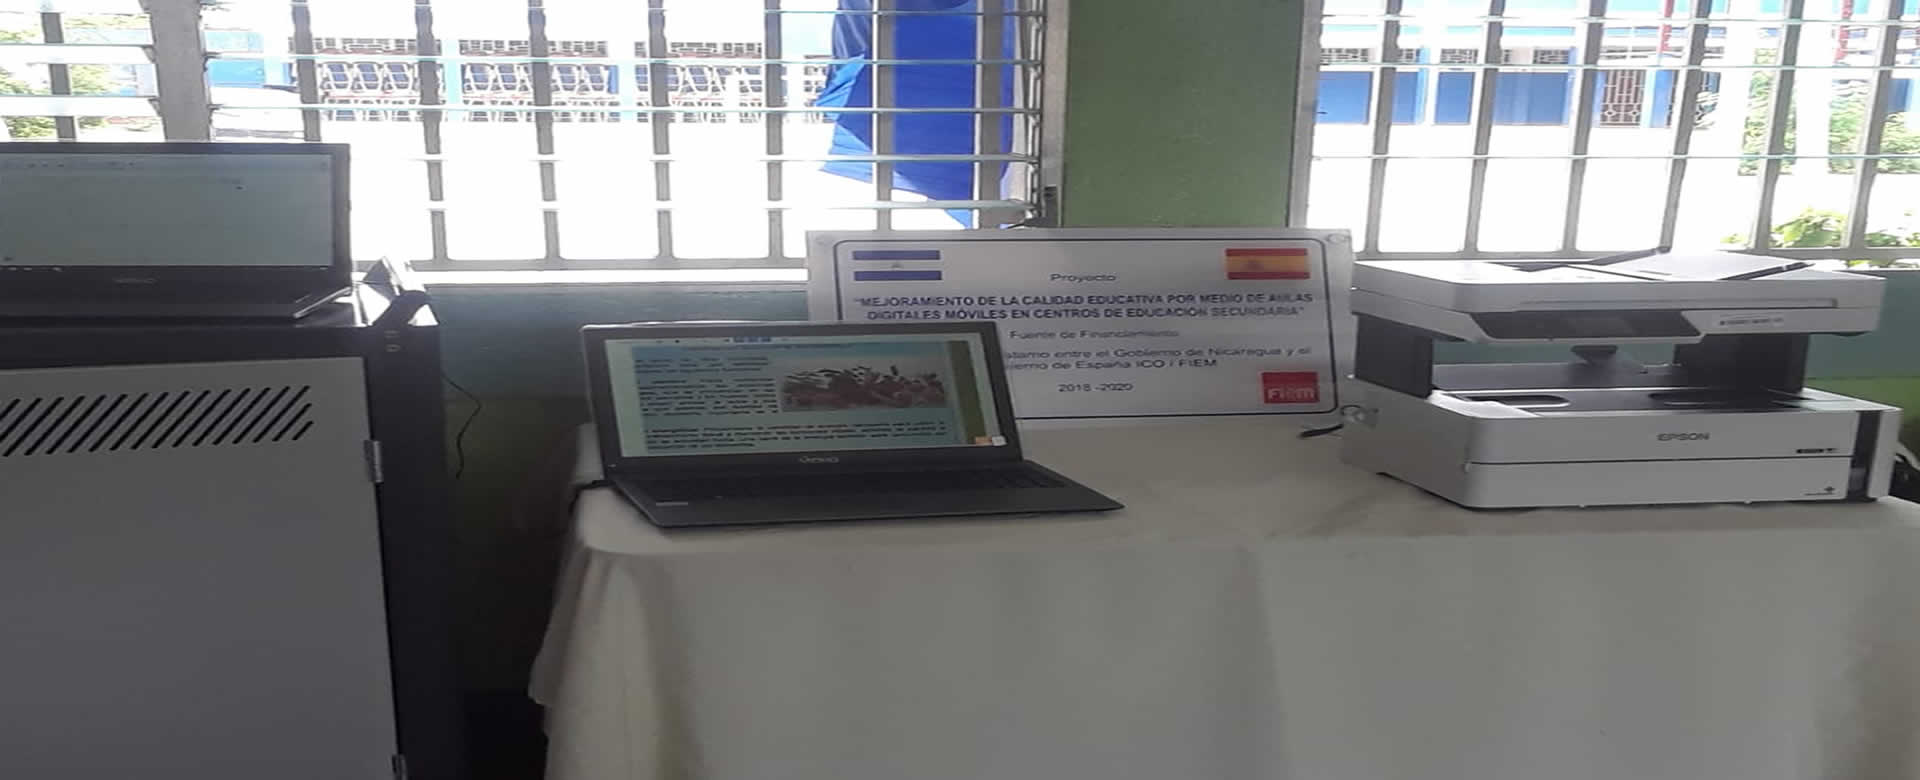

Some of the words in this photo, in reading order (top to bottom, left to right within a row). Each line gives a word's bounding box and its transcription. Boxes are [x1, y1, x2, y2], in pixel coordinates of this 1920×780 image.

[1050, 273, 1117, 282] Proyecto
[978, 296, 997, 306] DE
[1001, 296, 1018, 305] LA
[1022, 296, 1083, 305] CALIDAD
[1087, 295, 1164, 304] EDUCATIVA
[1167, 294, 1194, 304] POR
[1199, 294, 1243, 303] MEDIO
[1247, 294, 1265, 303] DE
[868, 310, 941, 321] DIGITALES
[945, 308, 1007, 320] MÓVILES
[1011, 310, 1030, 319] EN
[1032, 308, 1100, 319] CENTROS
[1104, 308, 1123, 318] DE
[1054, 350, 1092, 358] entre
[1114, 348, 1182, 358] Gobierno
[1186, 348, 1204, 357] de
[1209, 347, 1281, 357] Nicaragua
[1052, 361, 1071, 370] de
[1076, 360, 1131, 370] España
[1136, 359, 1165, 369] ICO
[1179, 358, 1218, 368] FIEM
[1058, 383, 1091, 392] 2018
[1657, 432, 1710, 441] EPSON
